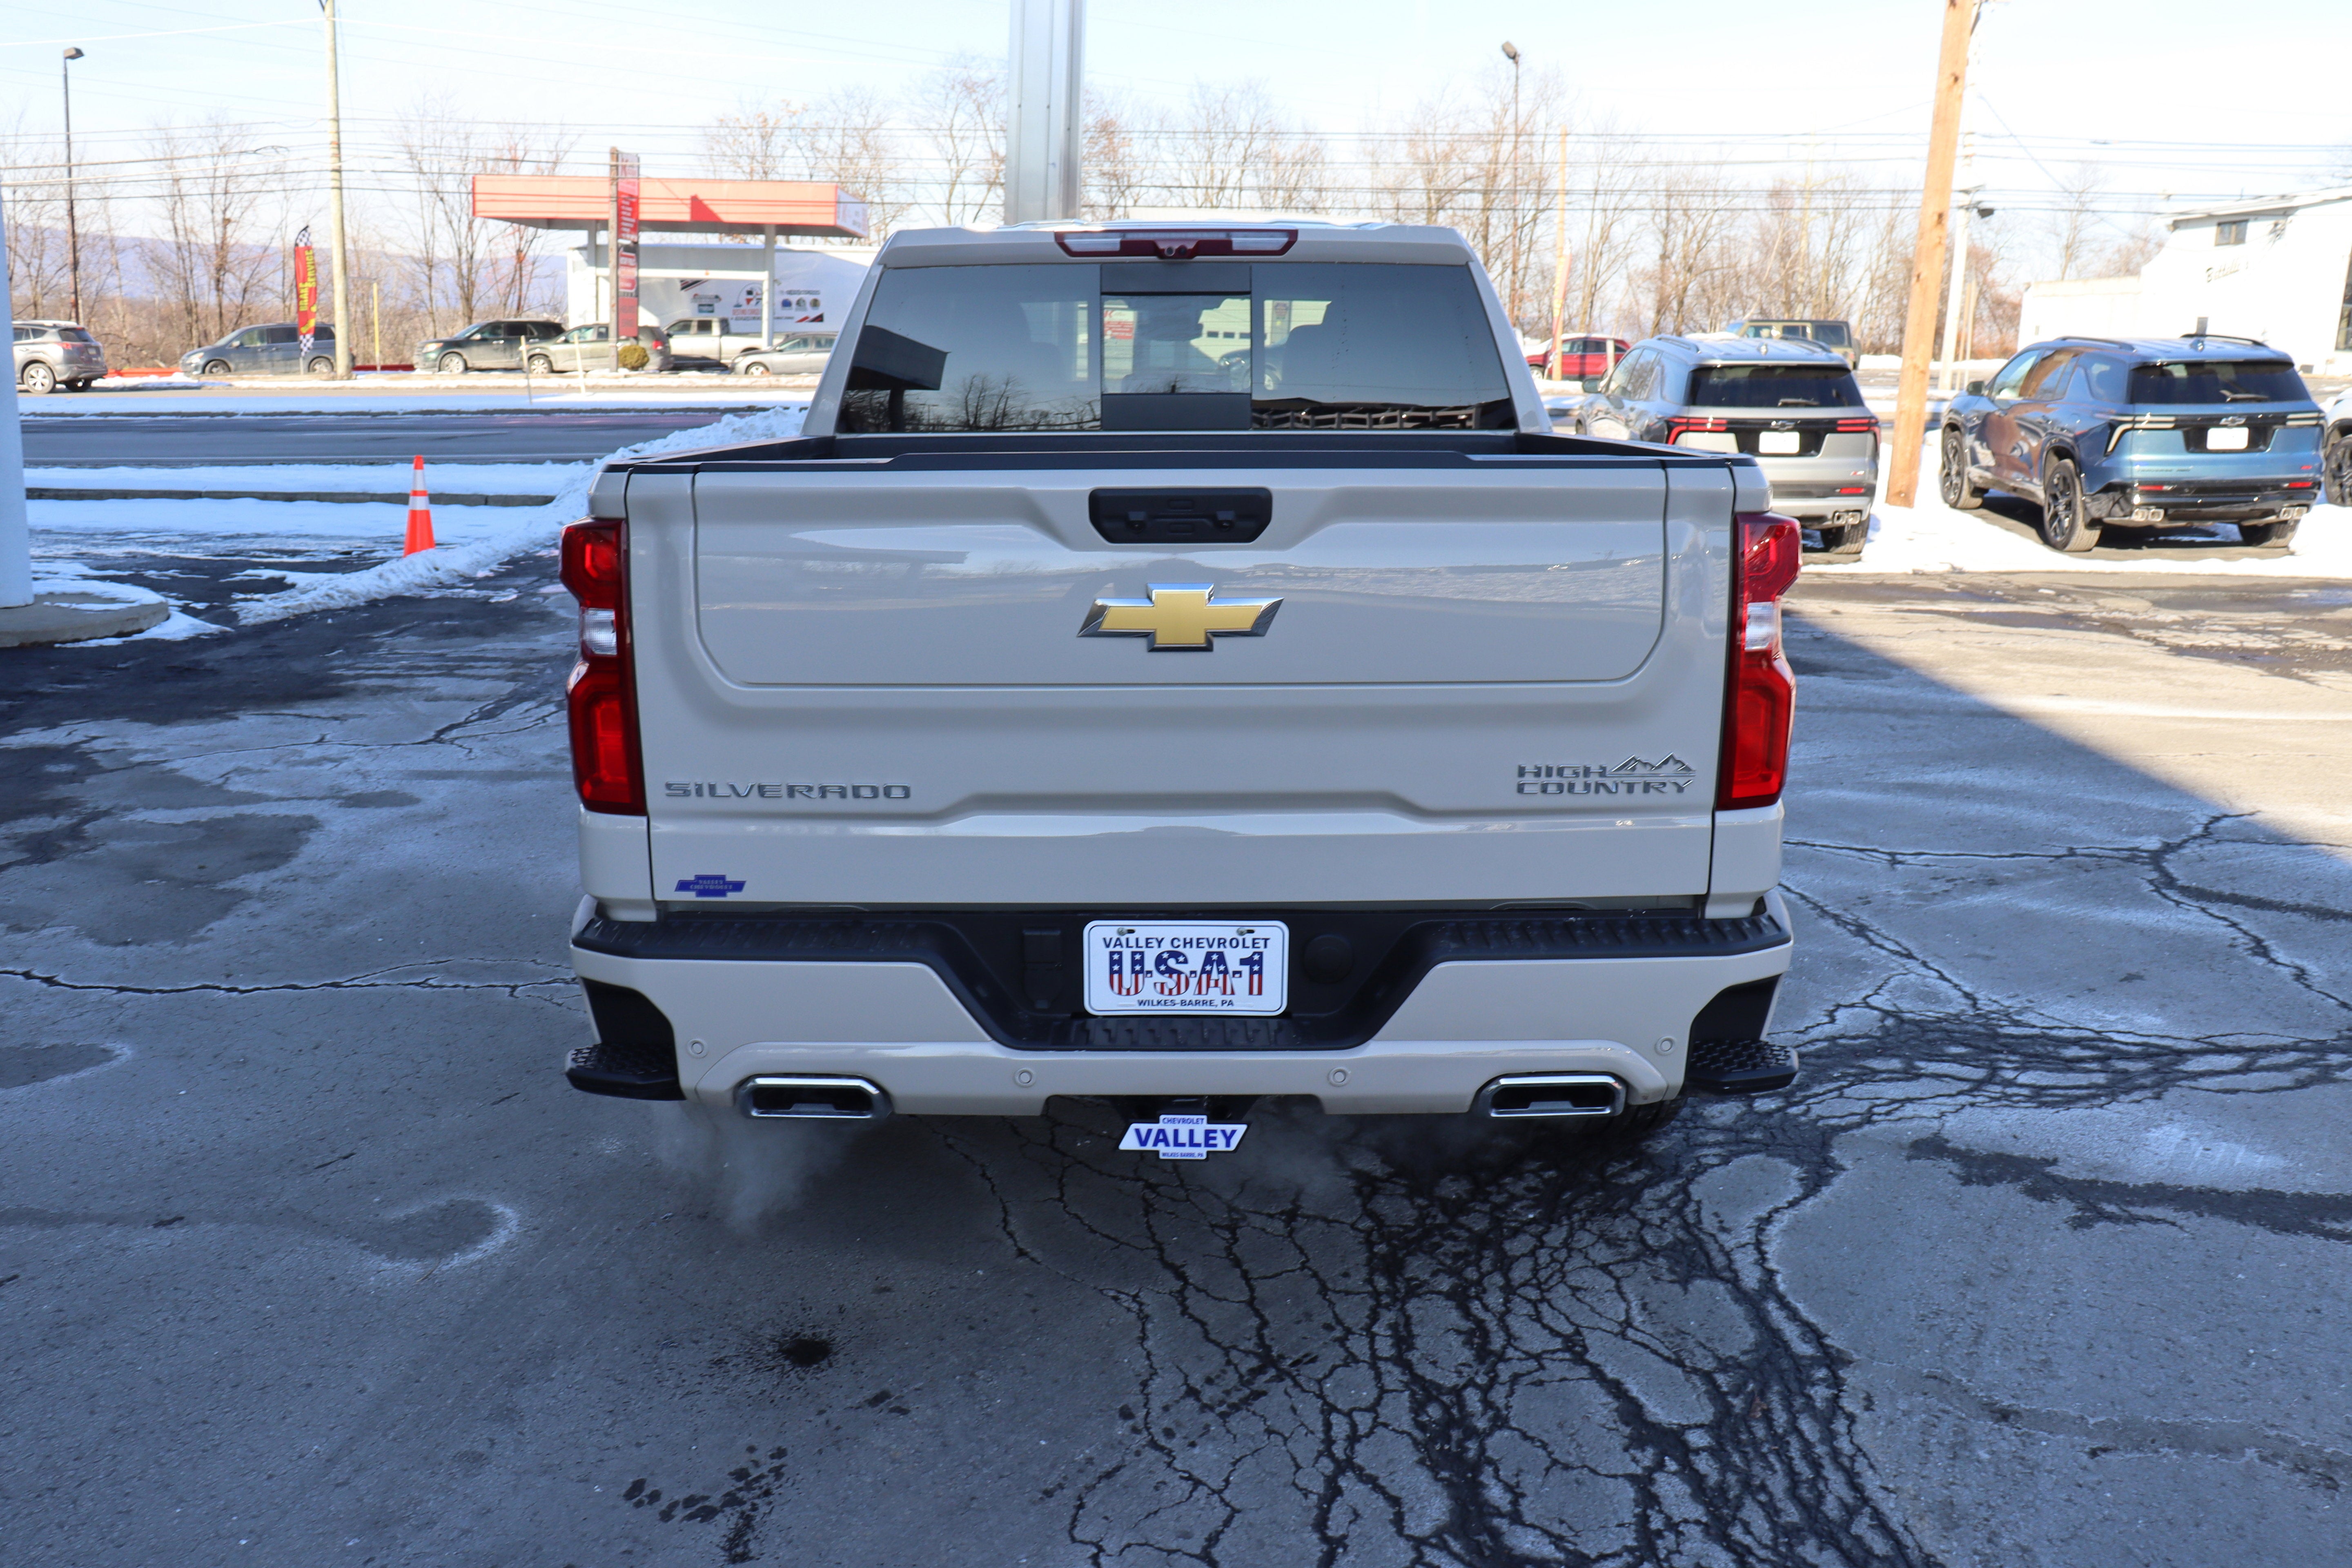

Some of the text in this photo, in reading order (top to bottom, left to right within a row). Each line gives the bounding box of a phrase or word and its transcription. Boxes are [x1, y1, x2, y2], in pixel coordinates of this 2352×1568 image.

[298, 282, 309, 312] BRAKE
[1517, 764, 1608, 778] HIGH
[665, 781, 911, 799] SILVERADO
[1517, 780, 1694, 794] COUNTRY
[1102, 937, 1271, 949] VALLEY CHEVROLET
[1137, 999, 1218, 1008] WILKES-BARRE,
[1134, 1128, 1238, 1148] VALLEY
